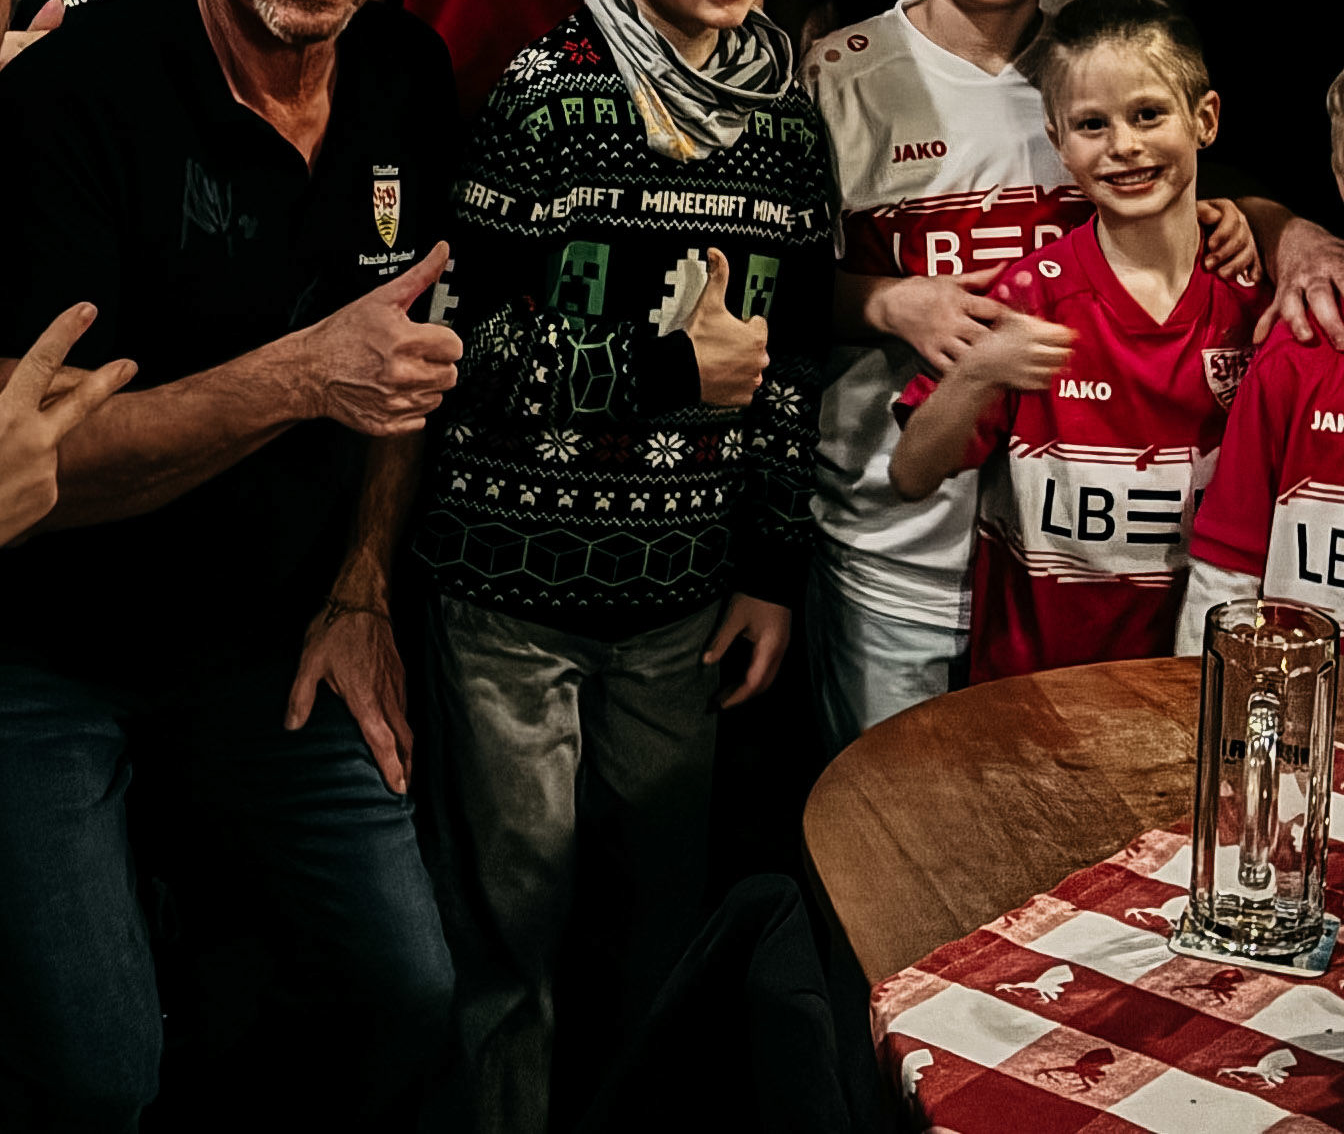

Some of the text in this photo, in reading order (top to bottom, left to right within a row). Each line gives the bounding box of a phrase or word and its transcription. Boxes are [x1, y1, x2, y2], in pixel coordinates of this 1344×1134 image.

[891, 139, 949, 164] JAKO
[641, 189, 747, 218] MINECRAFT
[1059, 379, 1112, 401] JAKO
